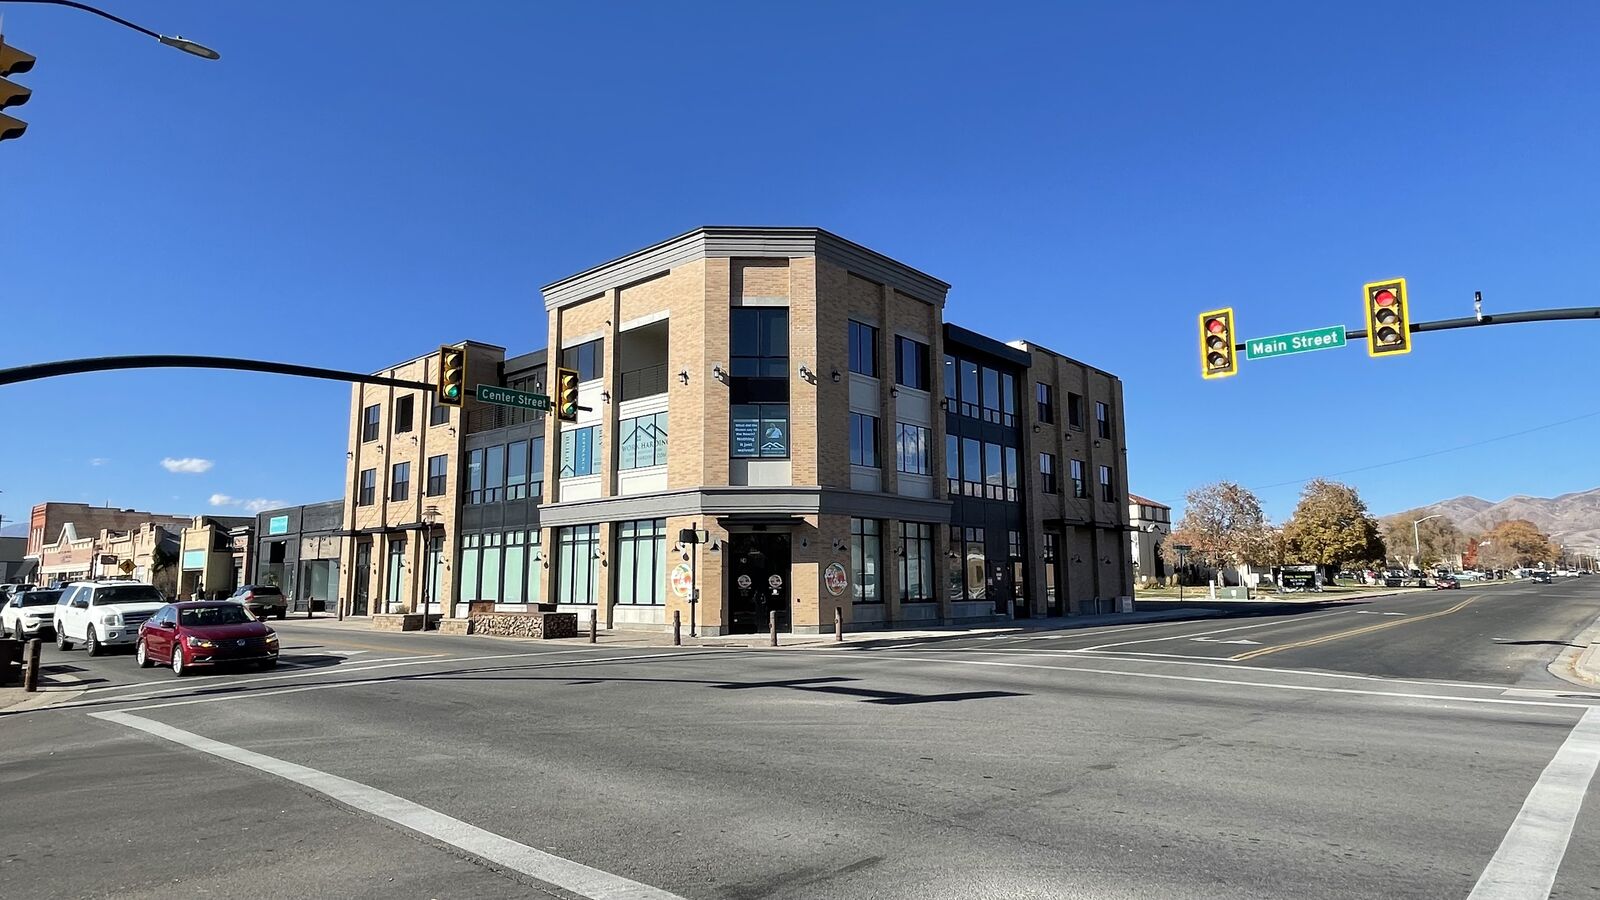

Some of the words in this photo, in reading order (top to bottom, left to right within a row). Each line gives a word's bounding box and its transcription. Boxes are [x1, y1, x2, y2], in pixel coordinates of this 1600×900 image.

[1253, 340, 1287, 355] Main
[1292, 331, 1338, 349] Street
[482, 389, 516, 403] Center
[518, 394, 546, 408] Street
